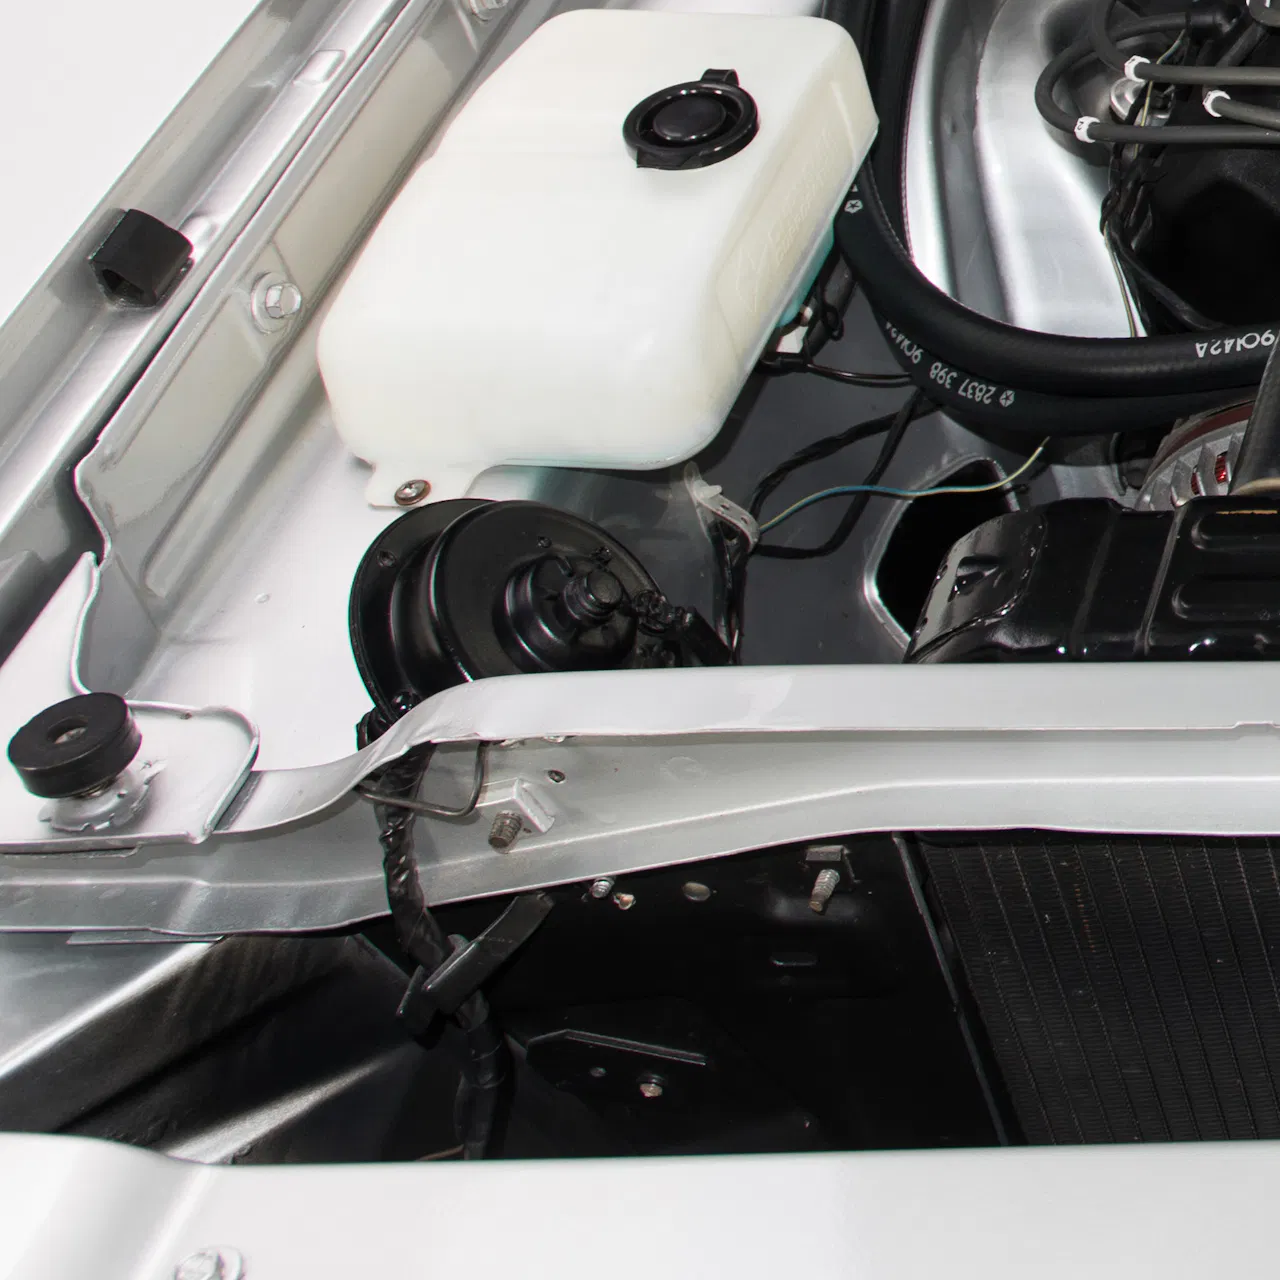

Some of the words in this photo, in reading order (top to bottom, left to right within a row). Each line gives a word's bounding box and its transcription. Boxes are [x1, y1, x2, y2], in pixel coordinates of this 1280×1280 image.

[1194, 329, 1275, 358] 90142A
[925, 359, 960, 391] 398
[956, 374, 998, 407] 2837
